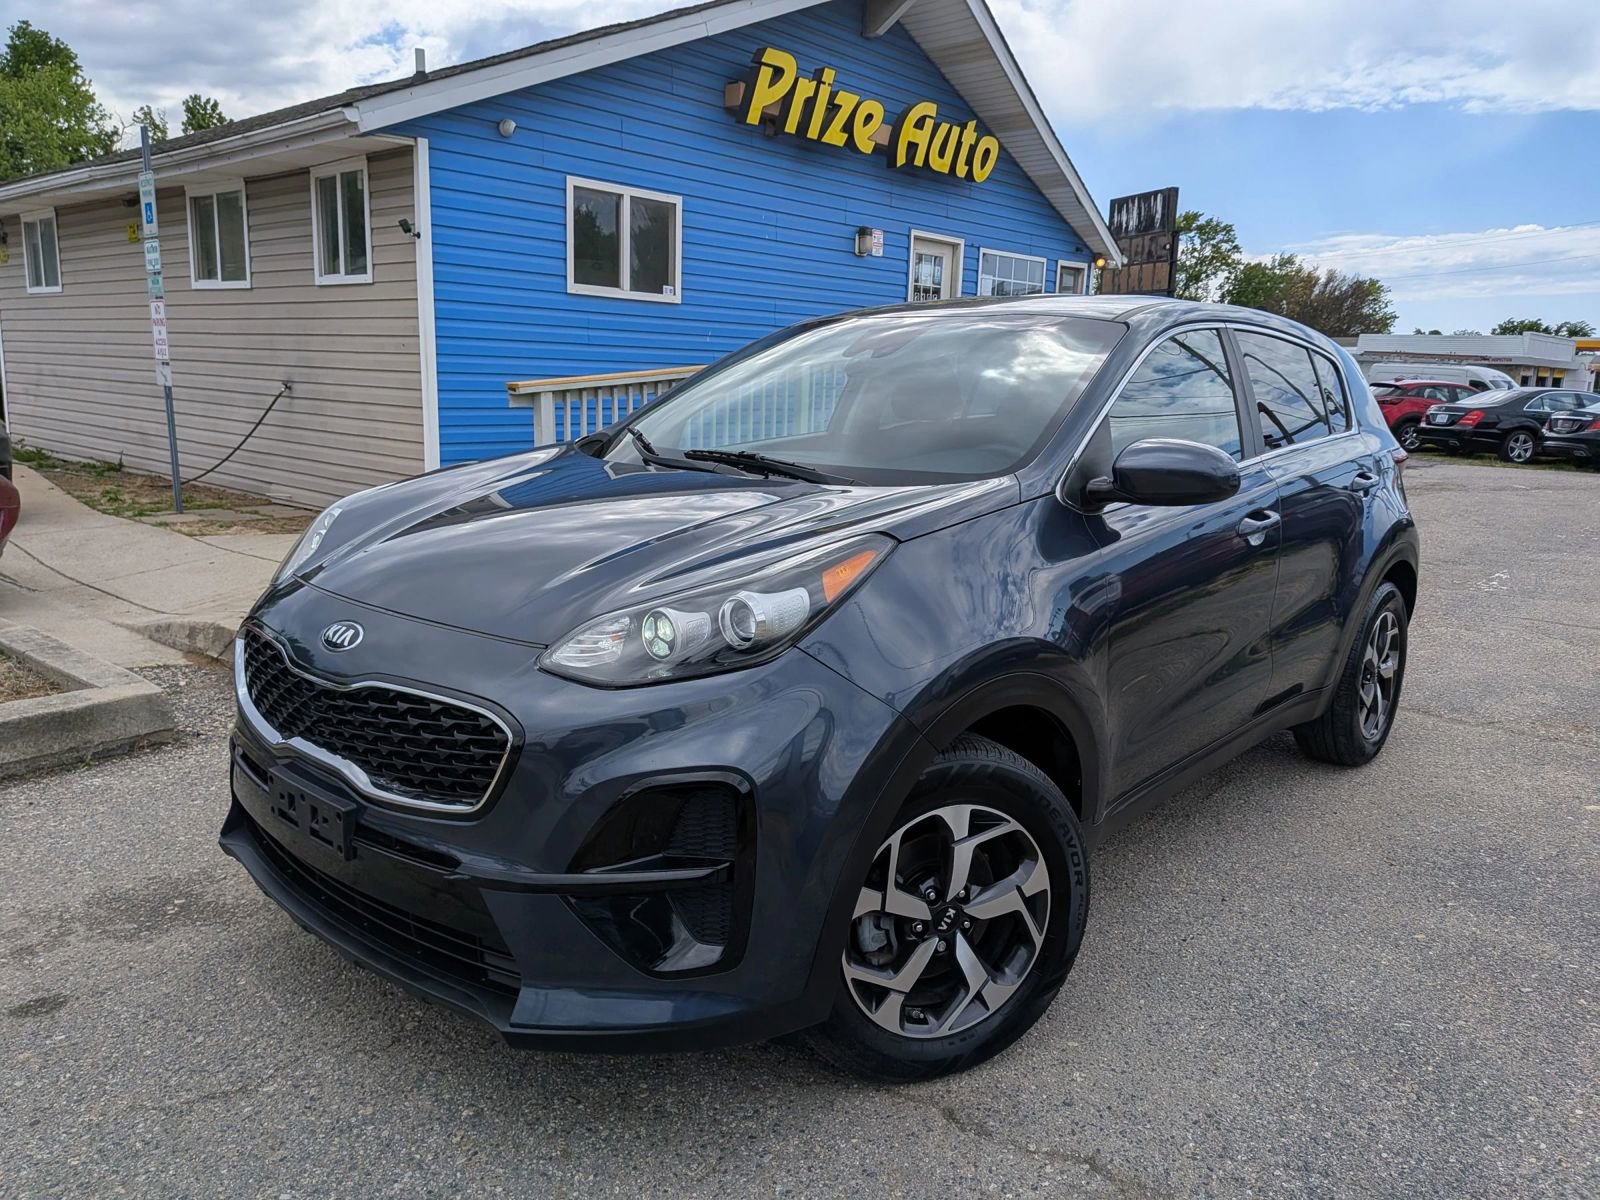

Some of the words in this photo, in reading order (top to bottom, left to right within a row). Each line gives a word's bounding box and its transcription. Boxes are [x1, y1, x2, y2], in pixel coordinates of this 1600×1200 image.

[746, 47, 885, 154] Prize
[897, 101, 999, 183] Auto
[323, 623, 356, 647] KIA
[937, 907, 957, 930] KIA
